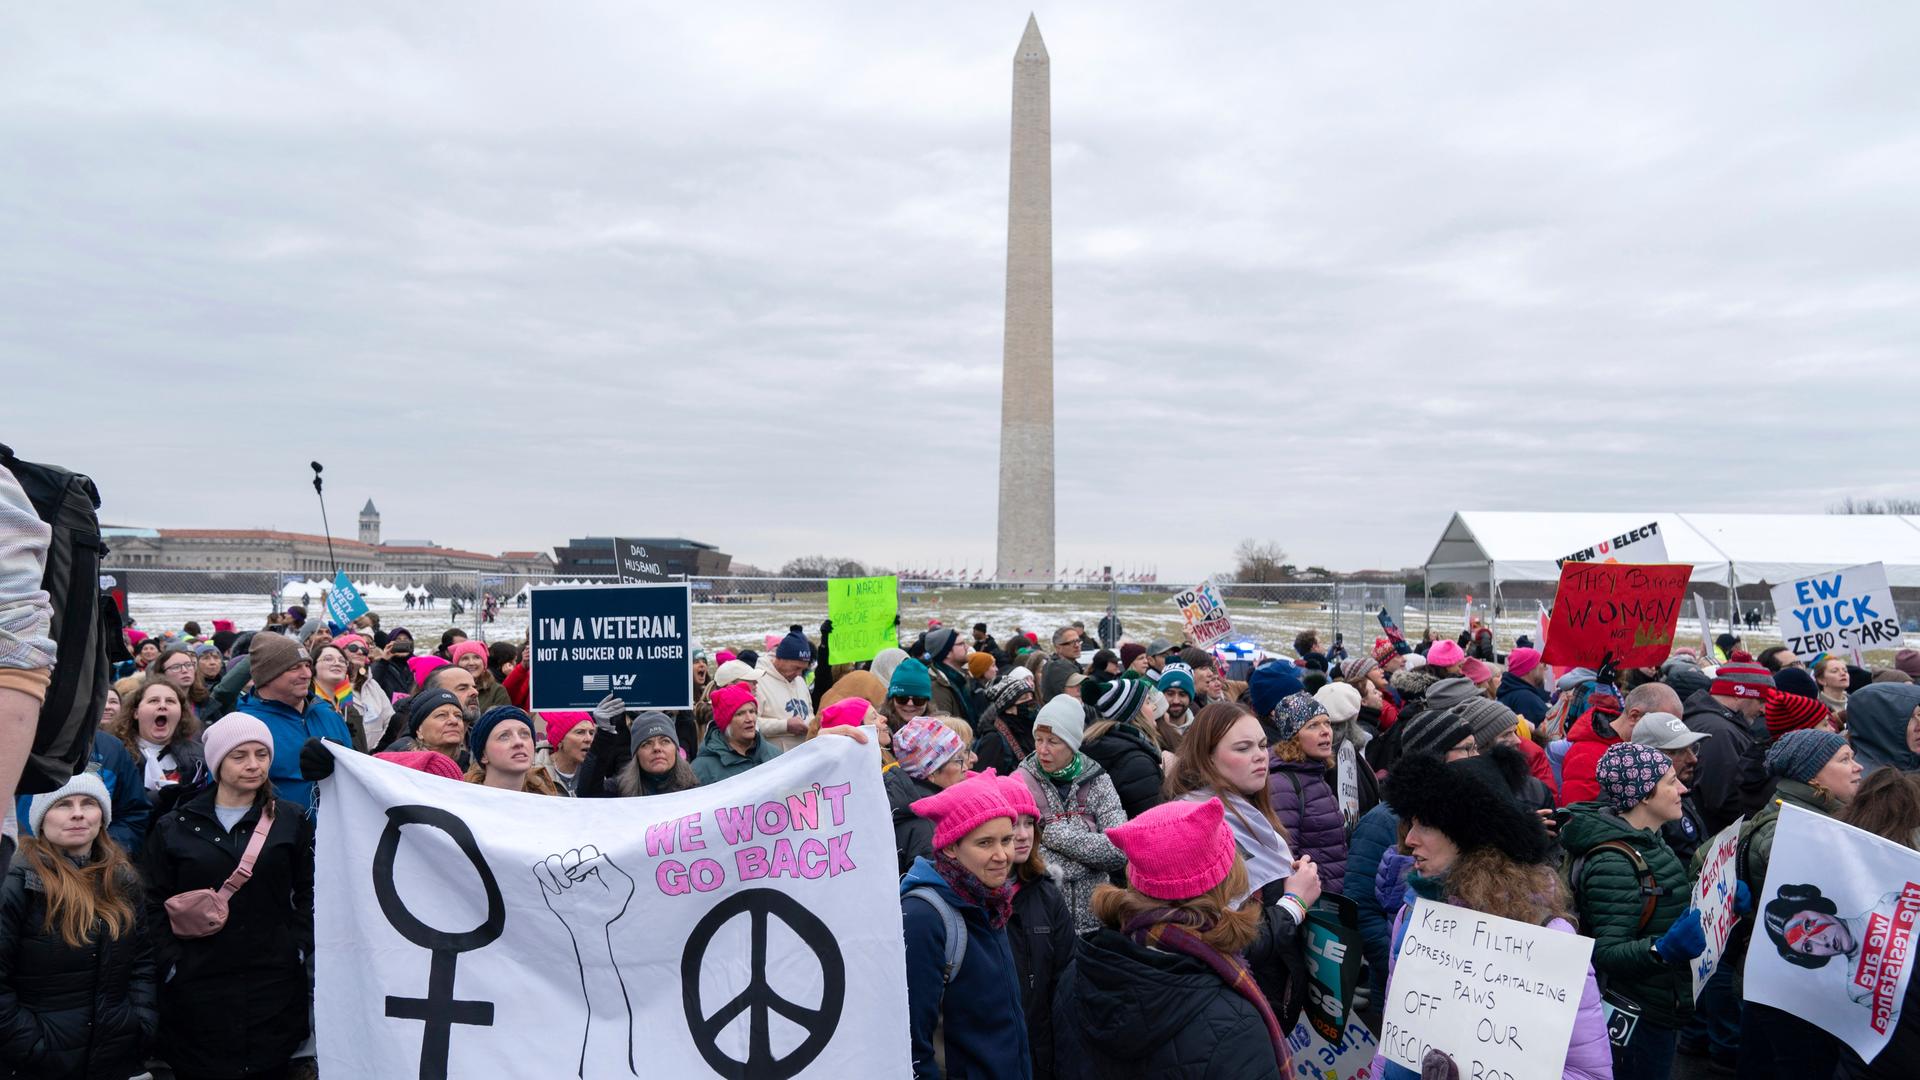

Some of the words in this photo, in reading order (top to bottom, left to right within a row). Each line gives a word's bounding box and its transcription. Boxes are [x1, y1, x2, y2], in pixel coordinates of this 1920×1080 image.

[630, 545, 649, 558] DAD.
[1598, 541, 1609, 554] U
[1613, 521, 1658, 550] ELECT
[624, 558, 663, 576] HUSBAND.
[341, 586, 355, 601] NO
[855, 580, 883, 596] MARCH
[1176, 591, 1195, 609] NO
[1795, 574, 1842, 605] EW
[1183, 586, 1219, 625] PRIDE
[1565, 597, 1677, 628] WOMEN
[1792, 595, 1879, 632] YUCK
[539, 618, 565, 640] I'M
[572, 618, 585, 640] A
[591, 616, 681, 640] VETERAN,
[1787, 632, 1834, 656] ZERO
[1838, 619, 1899, 649] STARS
[537, 648, 558, 662] NOT
[561, 648, 569, 661] A
[572, 647, 615, 660] SUCKER
[618, 647, 633, 660] OR
[636, 647, 644, 659] A
[647, 645, 683, 659] LOSER
[645, 812, 706, 857] WE
[714, 782, 851, 845] WON'T
[655, 858, 725, 896] GO
[735, 831, 856, 882] BACK
[1422, 908, 1457, 938] KEEP
[1452, 980, 1495, 1009] PAWS
[1484, 963, 1566, 1003] CAPITALIZING
[1404, 990, 1442, 1019] OFF
[1477, 1018, 1523, 1051] OUR
[1384, 1021, 1454, 1071] PRECI
